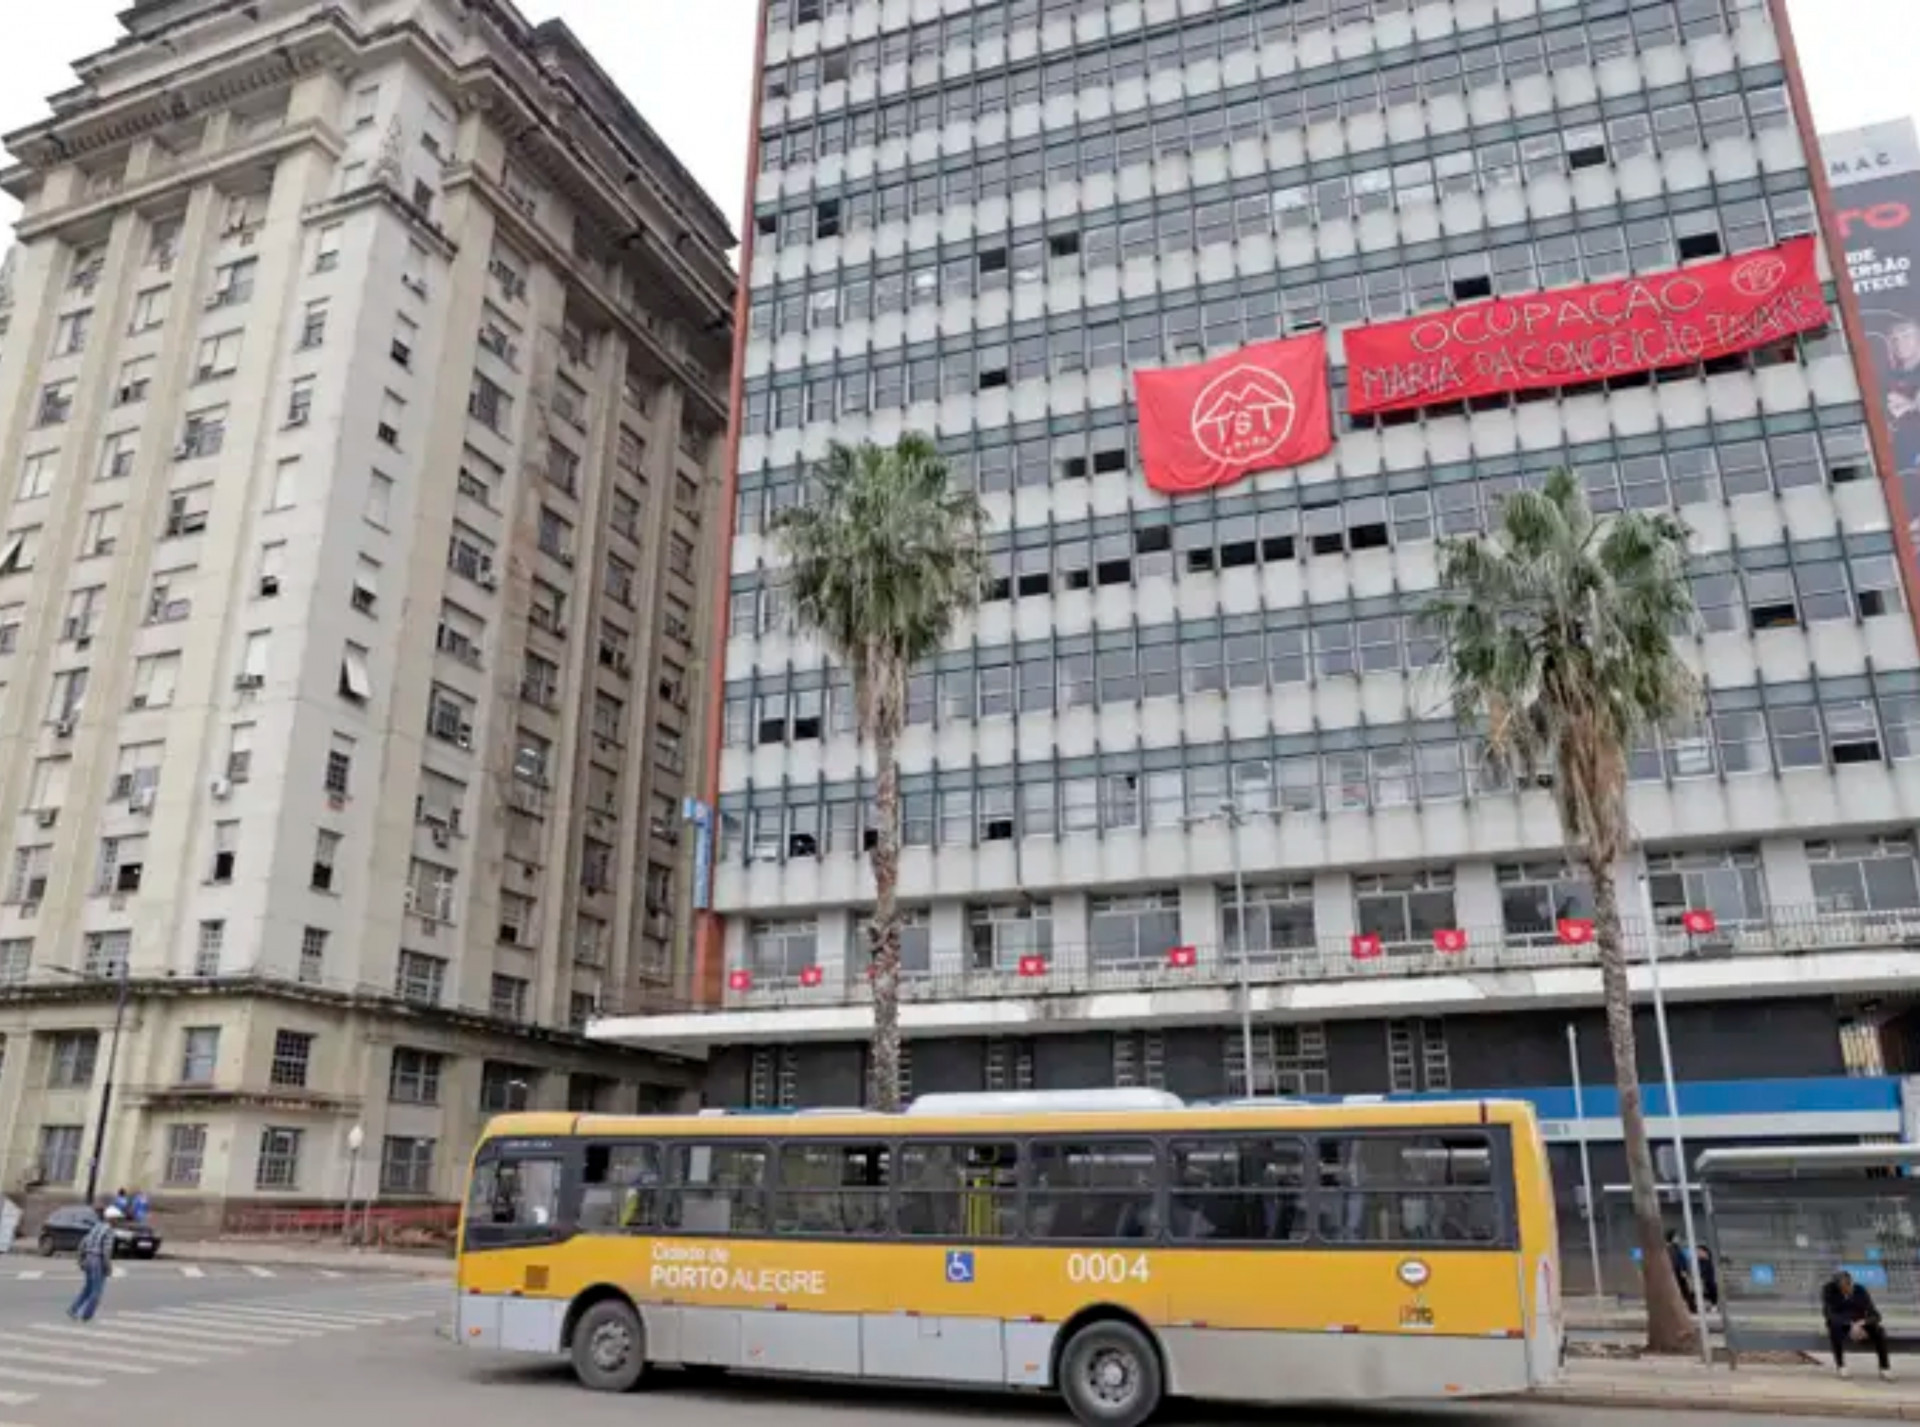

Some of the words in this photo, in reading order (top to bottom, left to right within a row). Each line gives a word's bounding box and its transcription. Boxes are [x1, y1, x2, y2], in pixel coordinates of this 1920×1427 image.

[1410, 276, 1704, 353] OCUPAÇÃO
[1362, 354, 1463, 401] MARIA
[650, 1264, 728, 1290] PORTO
[731, 1268, 826, 1295] ALEGRE
[1067, 1252, 1149, 1284] 0004
